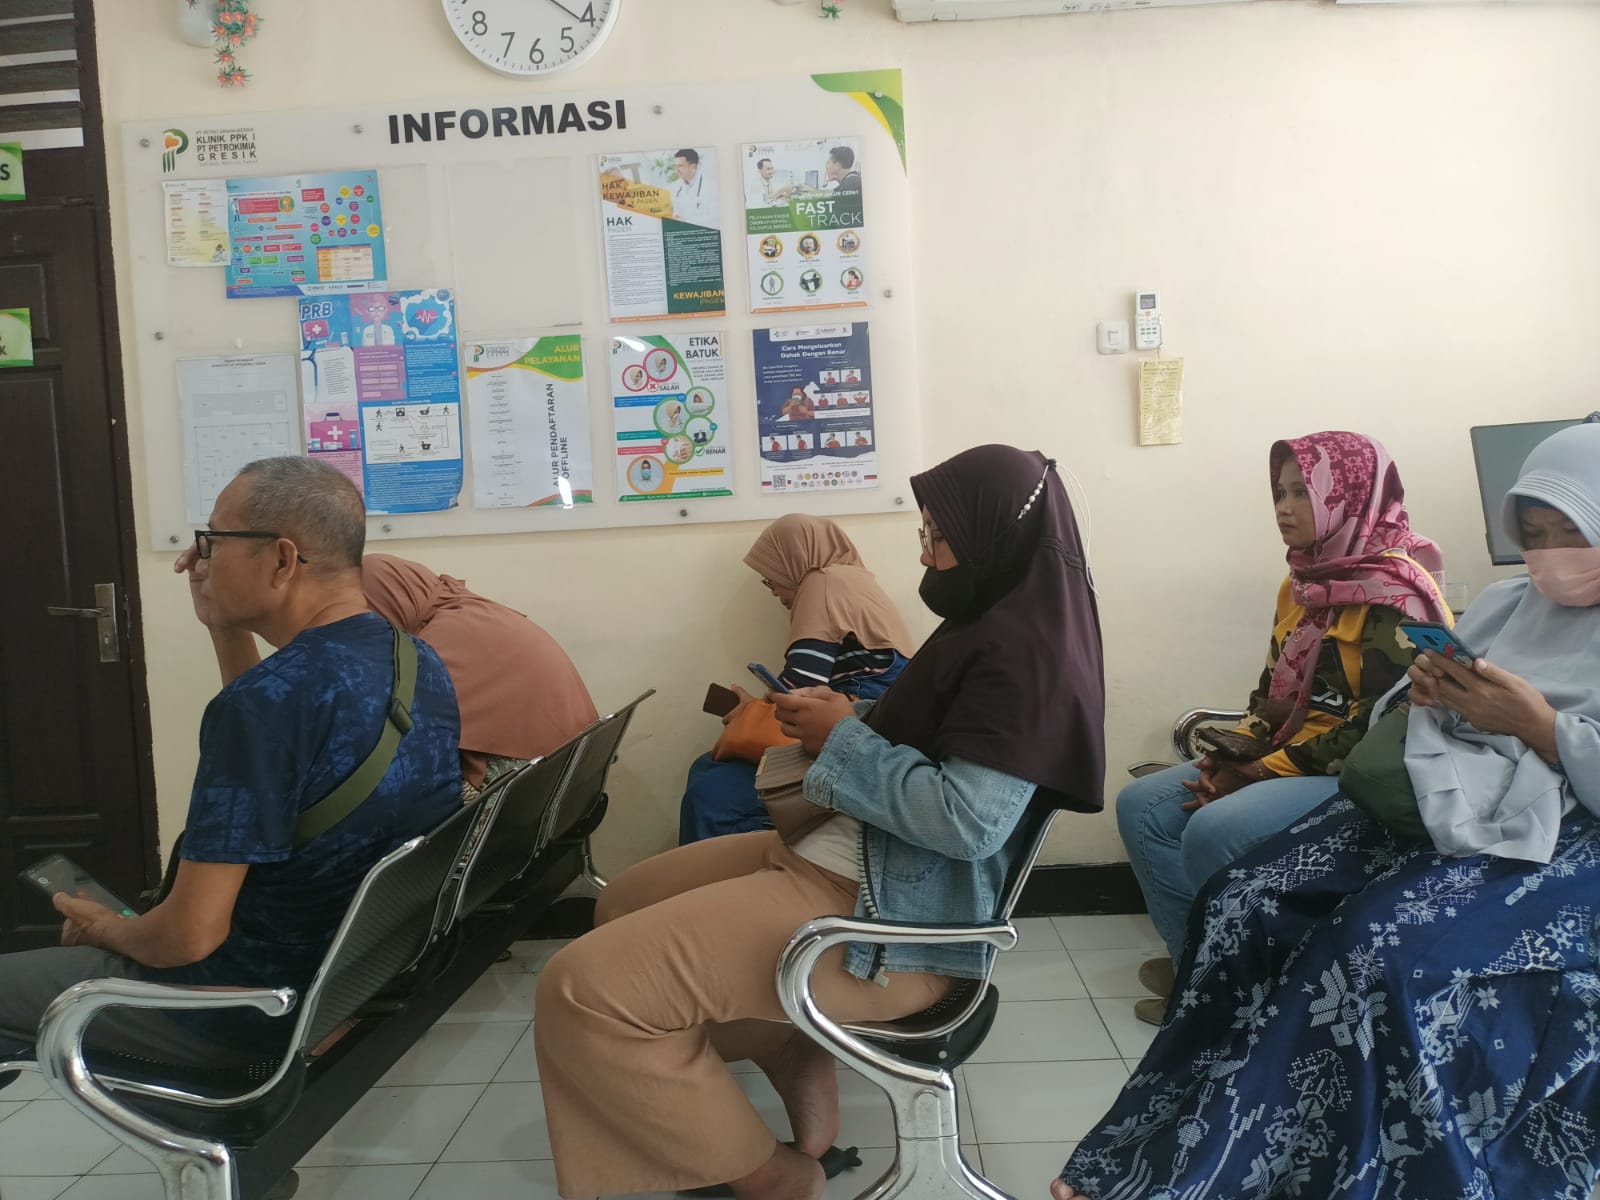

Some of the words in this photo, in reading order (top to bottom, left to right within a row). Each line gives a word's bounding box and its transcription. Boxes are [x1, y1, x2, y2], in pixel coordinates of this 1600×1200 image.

[579, 1, 597, 28] 4
[472, 10, 488, 36] 8
[500, 31, 516, 58] 7
[560, 26, 575, 53] 5
[529, 37, 545, 64] 6
[388, 99, 627, 145] INFORMASI
[196, 135, 226, 144] KLINIK
[230, 133, 249, 142] PPK
[197, 145, 206, 153] PT
[208, 142, 257, 152] PETROKIMIA
[197, 150, 257, 161] GRESIK
[602, 189, 660, 200] KEWAJIBAN
[795, 200, 836, 215] FAST
[606, 216, 633, 227] HAK
[808, 210, 863, 228] TRACK
[673, 289, 726, 300] KEWAJIBAN
[300, 301, 333, 321] PRB
[689, 336, 719, 347] ETIKA
[554, 344, 579, 353] ALUR
[685, 348, 719, 359] BATUK
[802, 350, 826, 358] Dengan
[523, 354, 580, 365] PELAYANAN
[659, 383, 680, 391] SALAH
[545, 383, 559, 461] PENDAFTARAN
[560, 437, 570, 479] OFFLINE
[551, 464, 560, 487] ALUR
